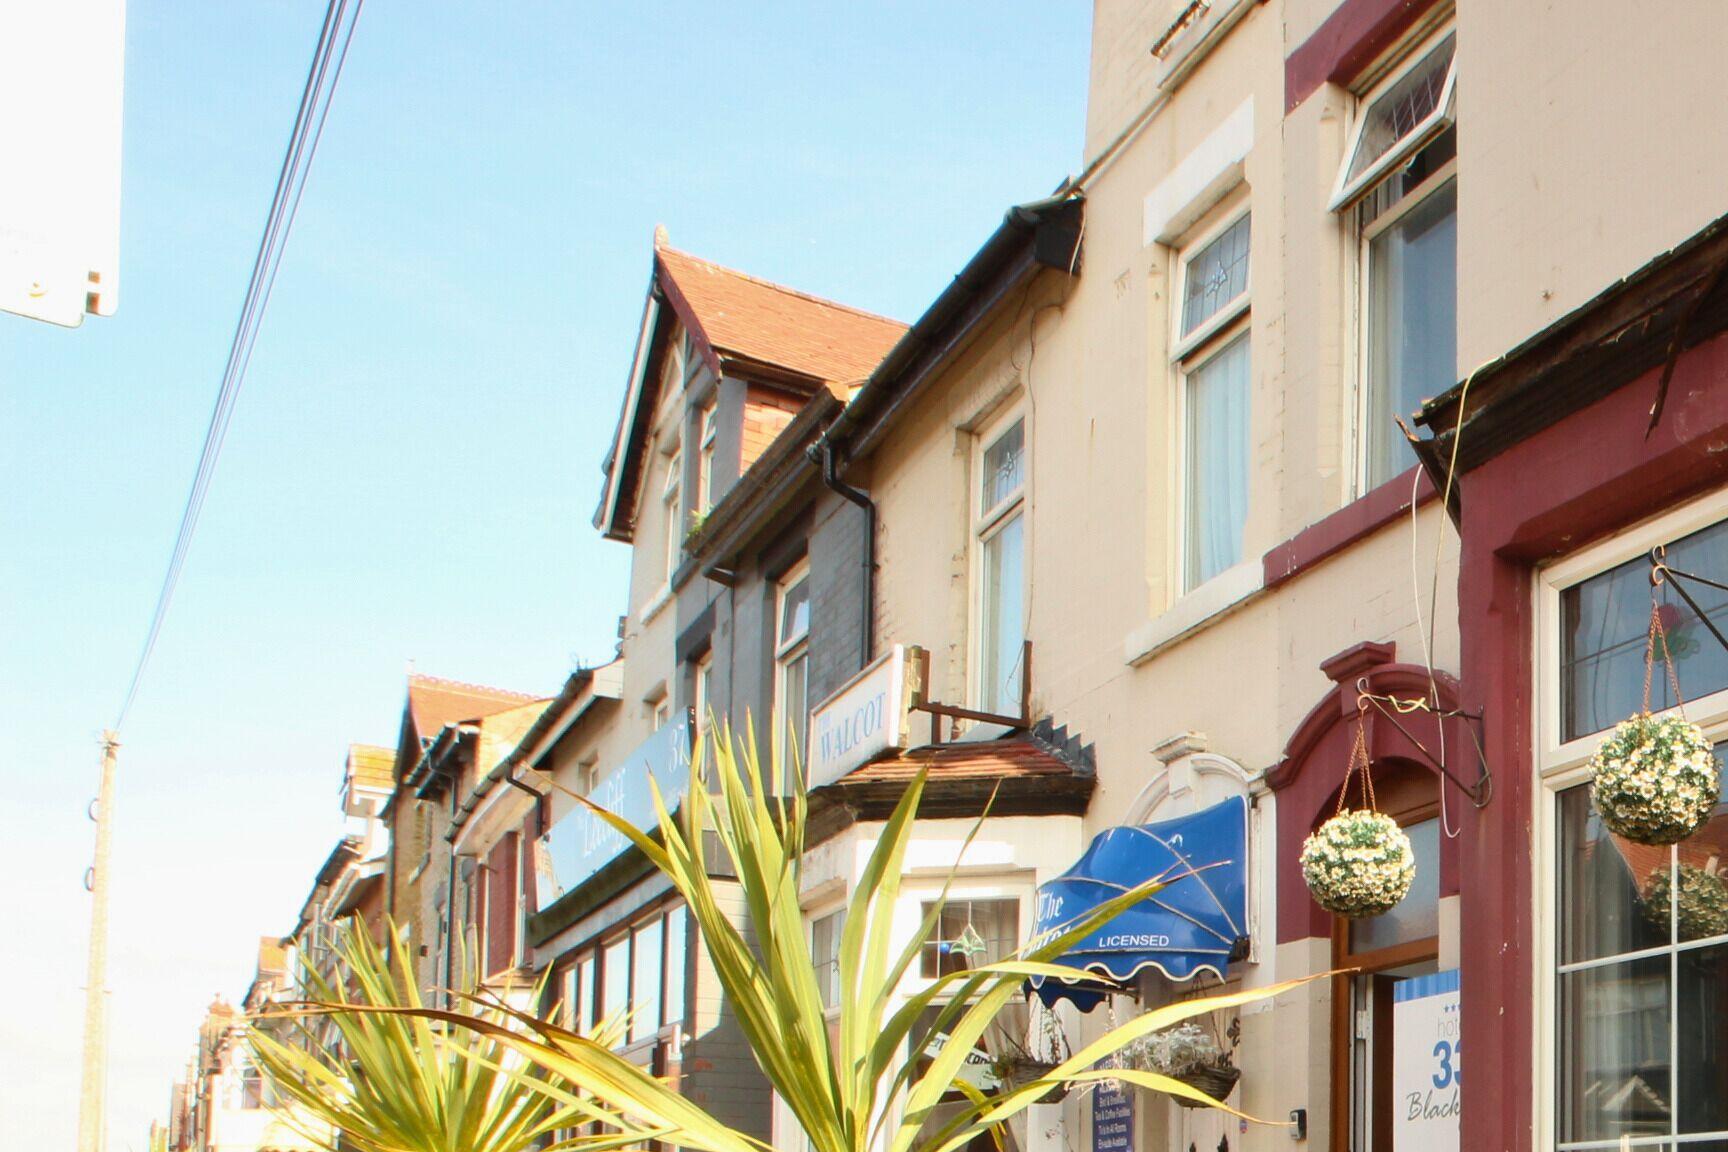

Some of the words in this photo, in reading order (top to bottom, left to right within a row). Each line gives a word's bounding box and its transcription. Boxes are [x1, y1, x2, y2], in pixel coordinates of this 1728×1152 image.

[821, 692, 886, 764] WALCOT
[1038, 890, 1064, 923] The
[1099, 935, 1170, 948] LICENSED
[1438, 1016, 1461, 1038] hot
